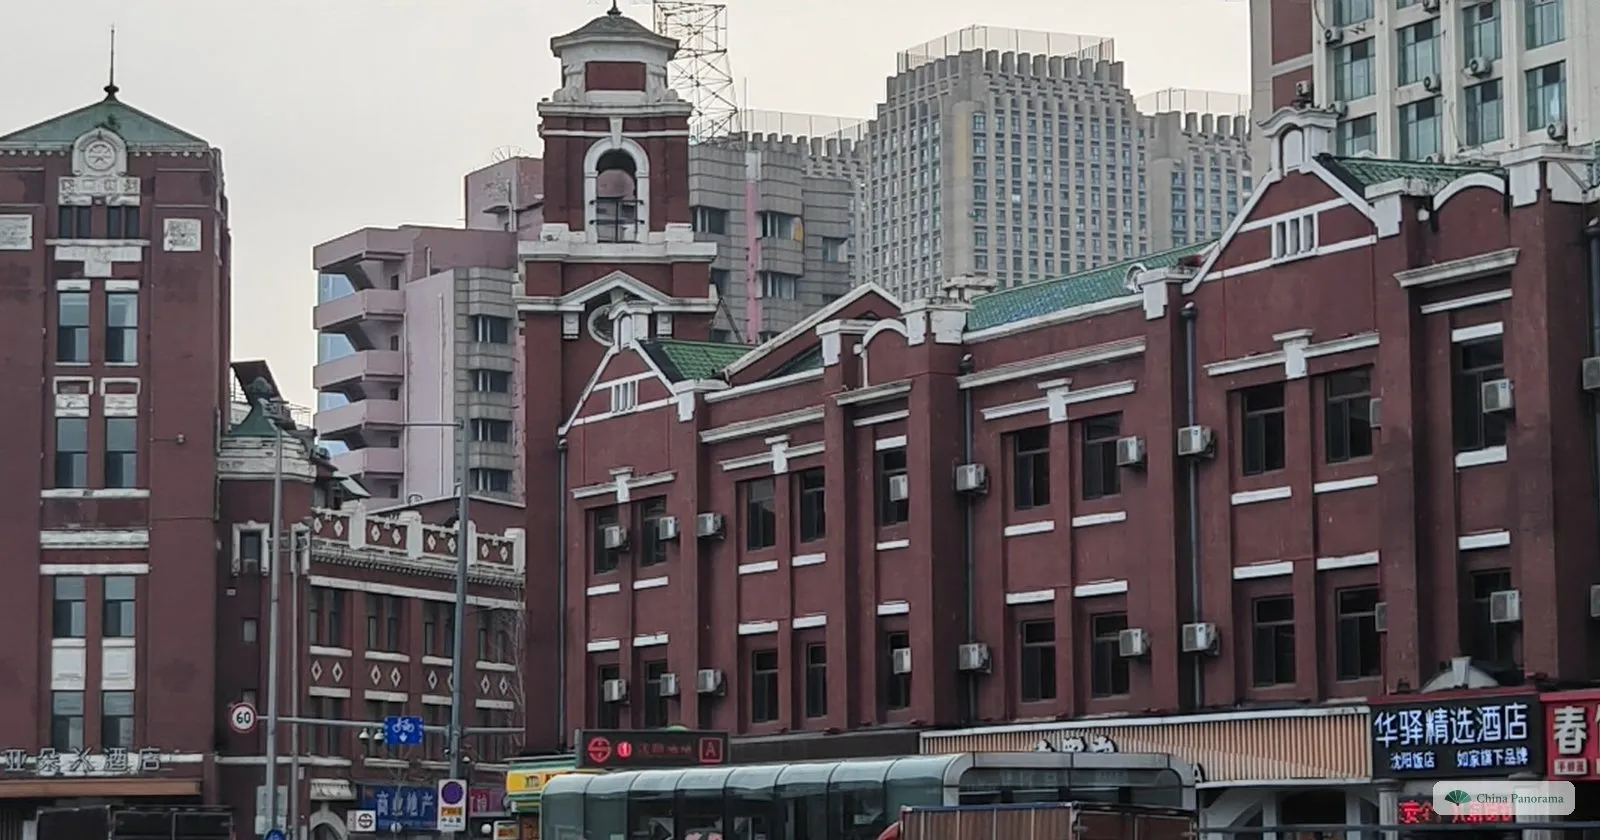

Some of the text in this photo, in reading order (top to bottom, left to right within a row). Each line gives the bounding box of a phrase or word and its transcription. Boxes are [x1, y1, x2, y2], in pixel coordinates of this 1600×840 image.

[235, 711, 251, 724] 60
[1374, 702, 1529, 749] 华驿精选酒店
[1553, 705, 1600, 755] 春
[705, 741, 717, 757] A
[1390, 746, 1529, 771] 沈阳饭店 如家旗下品牌
